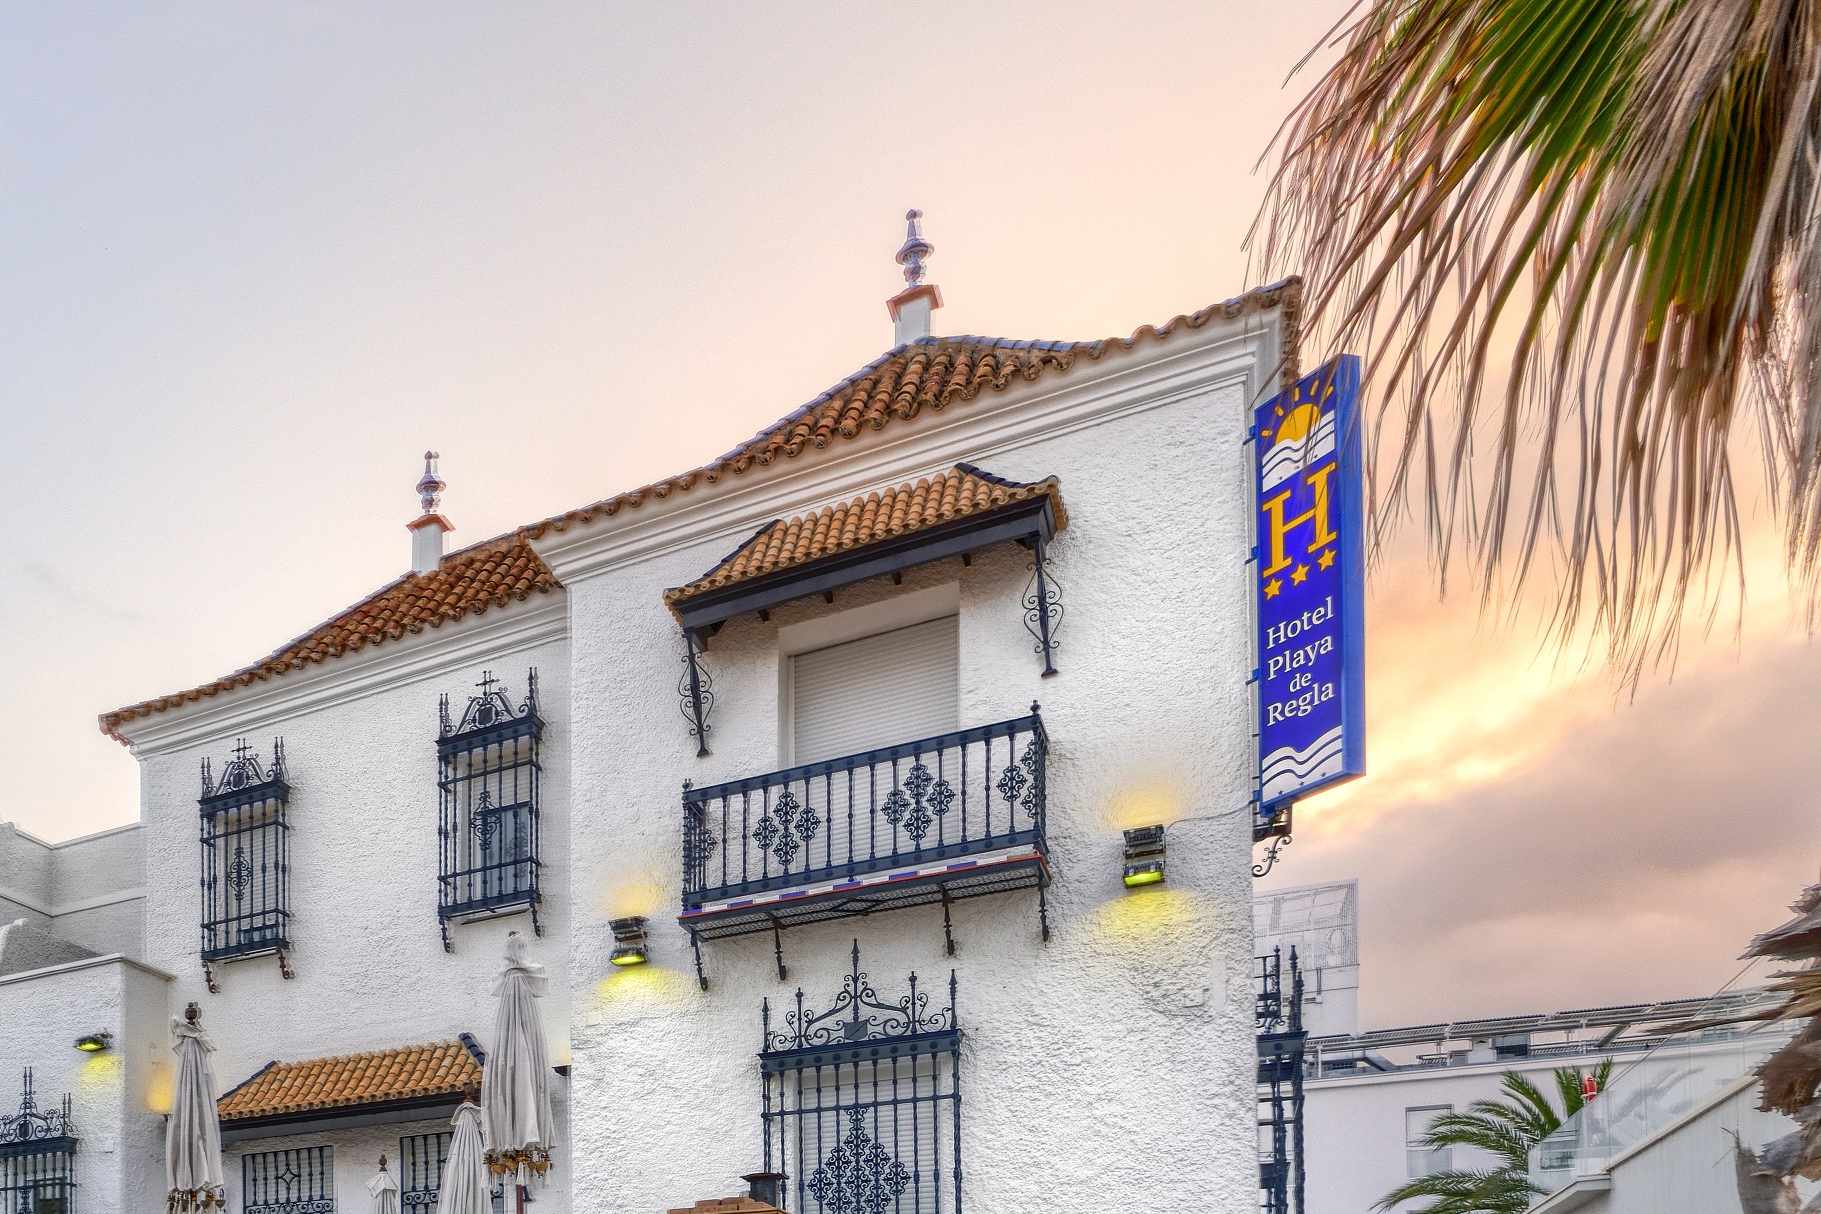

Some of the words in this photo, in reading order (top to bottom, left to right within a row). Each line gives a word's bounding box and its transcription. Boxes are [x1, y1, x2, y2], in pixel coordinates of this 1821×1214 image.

[1262, 461, 1337, 578] H
[1266, 596, 1334, 649] Hotel
[1267, 635, 1334, 680] Playa
[1267, 682, 1335, 726] Regla
[1289, 672, 1312, 692] de
